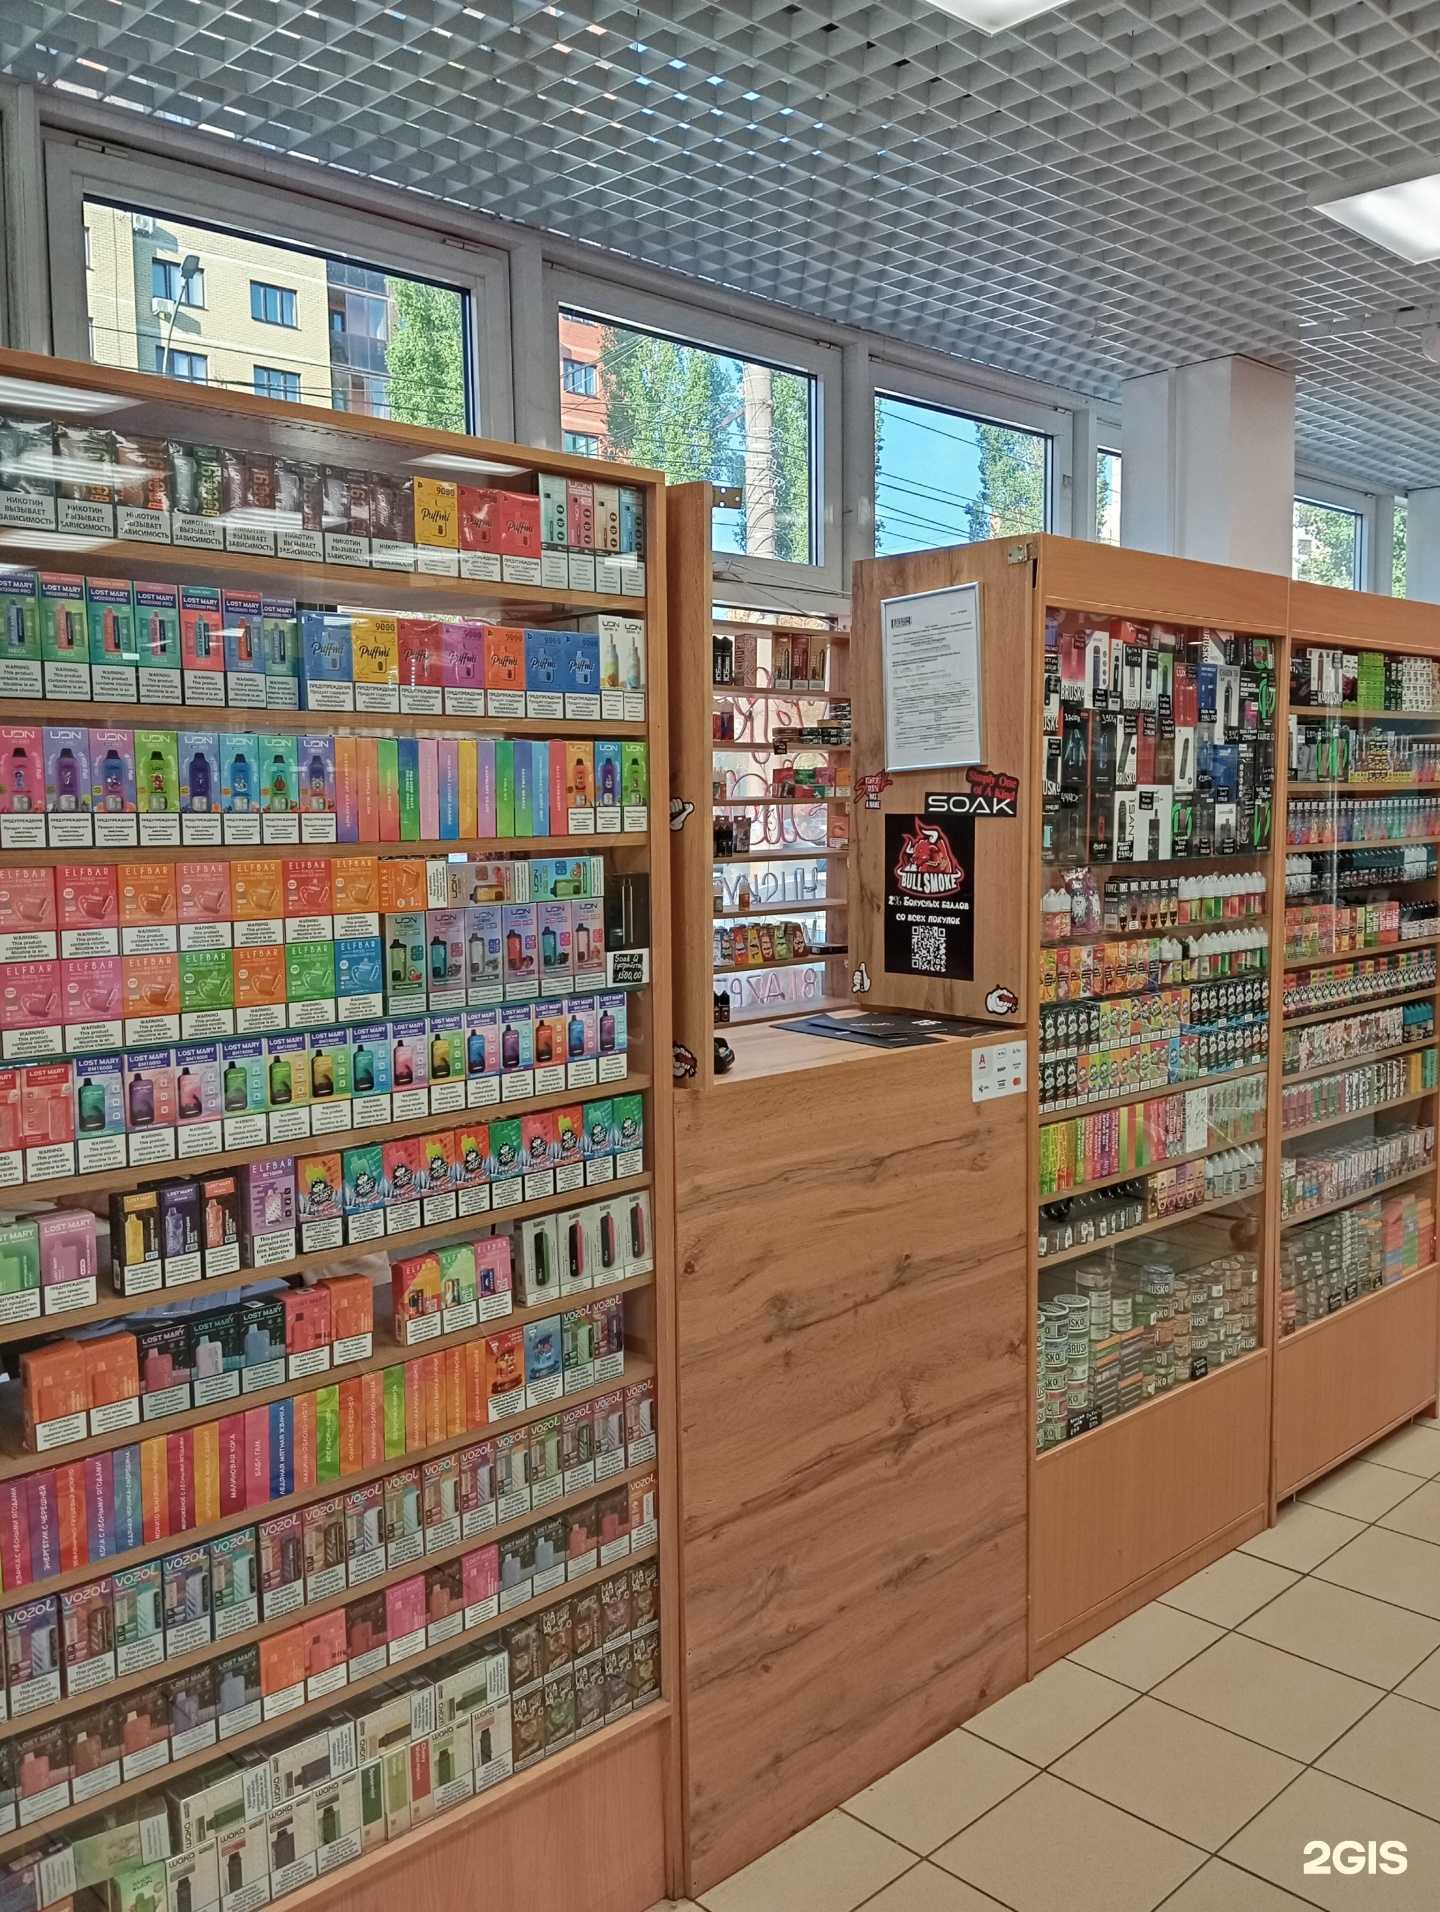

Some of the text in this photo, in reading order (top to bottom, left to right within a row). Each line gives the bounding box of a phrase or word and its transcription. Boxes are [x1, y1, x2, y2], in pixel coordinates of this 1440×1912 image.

[6, 496, 43, 506] НИКОТИН
[5, 505, 45, 515] ВЫЗЫВАЕТ
[421, 507, 450, 523] Puffmi
[42, 584, 81, 594] LOST MARY
[90, 588, 128, 597] LOST MARY
[137, 592, 174, 601] LOST MARY
[183, 597, 218, 606] LOST MARY
[226, 600, 259, 609] LOST MARY
[263, 605, 293, 614] LOST MARY
[359, 645, 391, 659] Puffmi
[928, 796, 1014, 814] SOAK
[125, 866, 168, 876] ELFBAR
[184, 865, 223, 874] ELFBAR
[237, 863, 275, 872] ELFBAR
[288, 861, 326, 871] ELFBAR
[65, 868, 109, 878] ELFBAR
[901, 872, 956, 893] BULL SMOKE
[291, 945, 329, 955] ELFBAR
[341, 941, 376, 951] ELFBAR
[185, 953, 226, 964] ELFBAR
[240, 950, 278, 960] ELFBAR
[69, 961, 113, 971] ELFBAR
[129, 957, 172, 967] ELFBAR
[311, 1030, 344, 1042] LOST MARY
[269, 1036, 303, 1047] LOST MARY
[224, 1042, 259, 1052] LOST MARY
[252, 1161, 294, 1173] ELFBAR
[44, 1220, 90, 1233] LOST MARY
[142, 1327, 185, 1346] LOST MARY
[229, 1454, 237, 1498] МАЛИНОВАЯ
[261, 1517, 301, 1537] VOZOL
[213, 1534, 254, 1554] VOZOL
[165, 1549, 208, 1570] VOZOL
[115, 1568, 160, 1588] VOZOL
[65, 1583, 110, 1607] VOZOL
[8, 1600, 55, 1625] VOZOL
